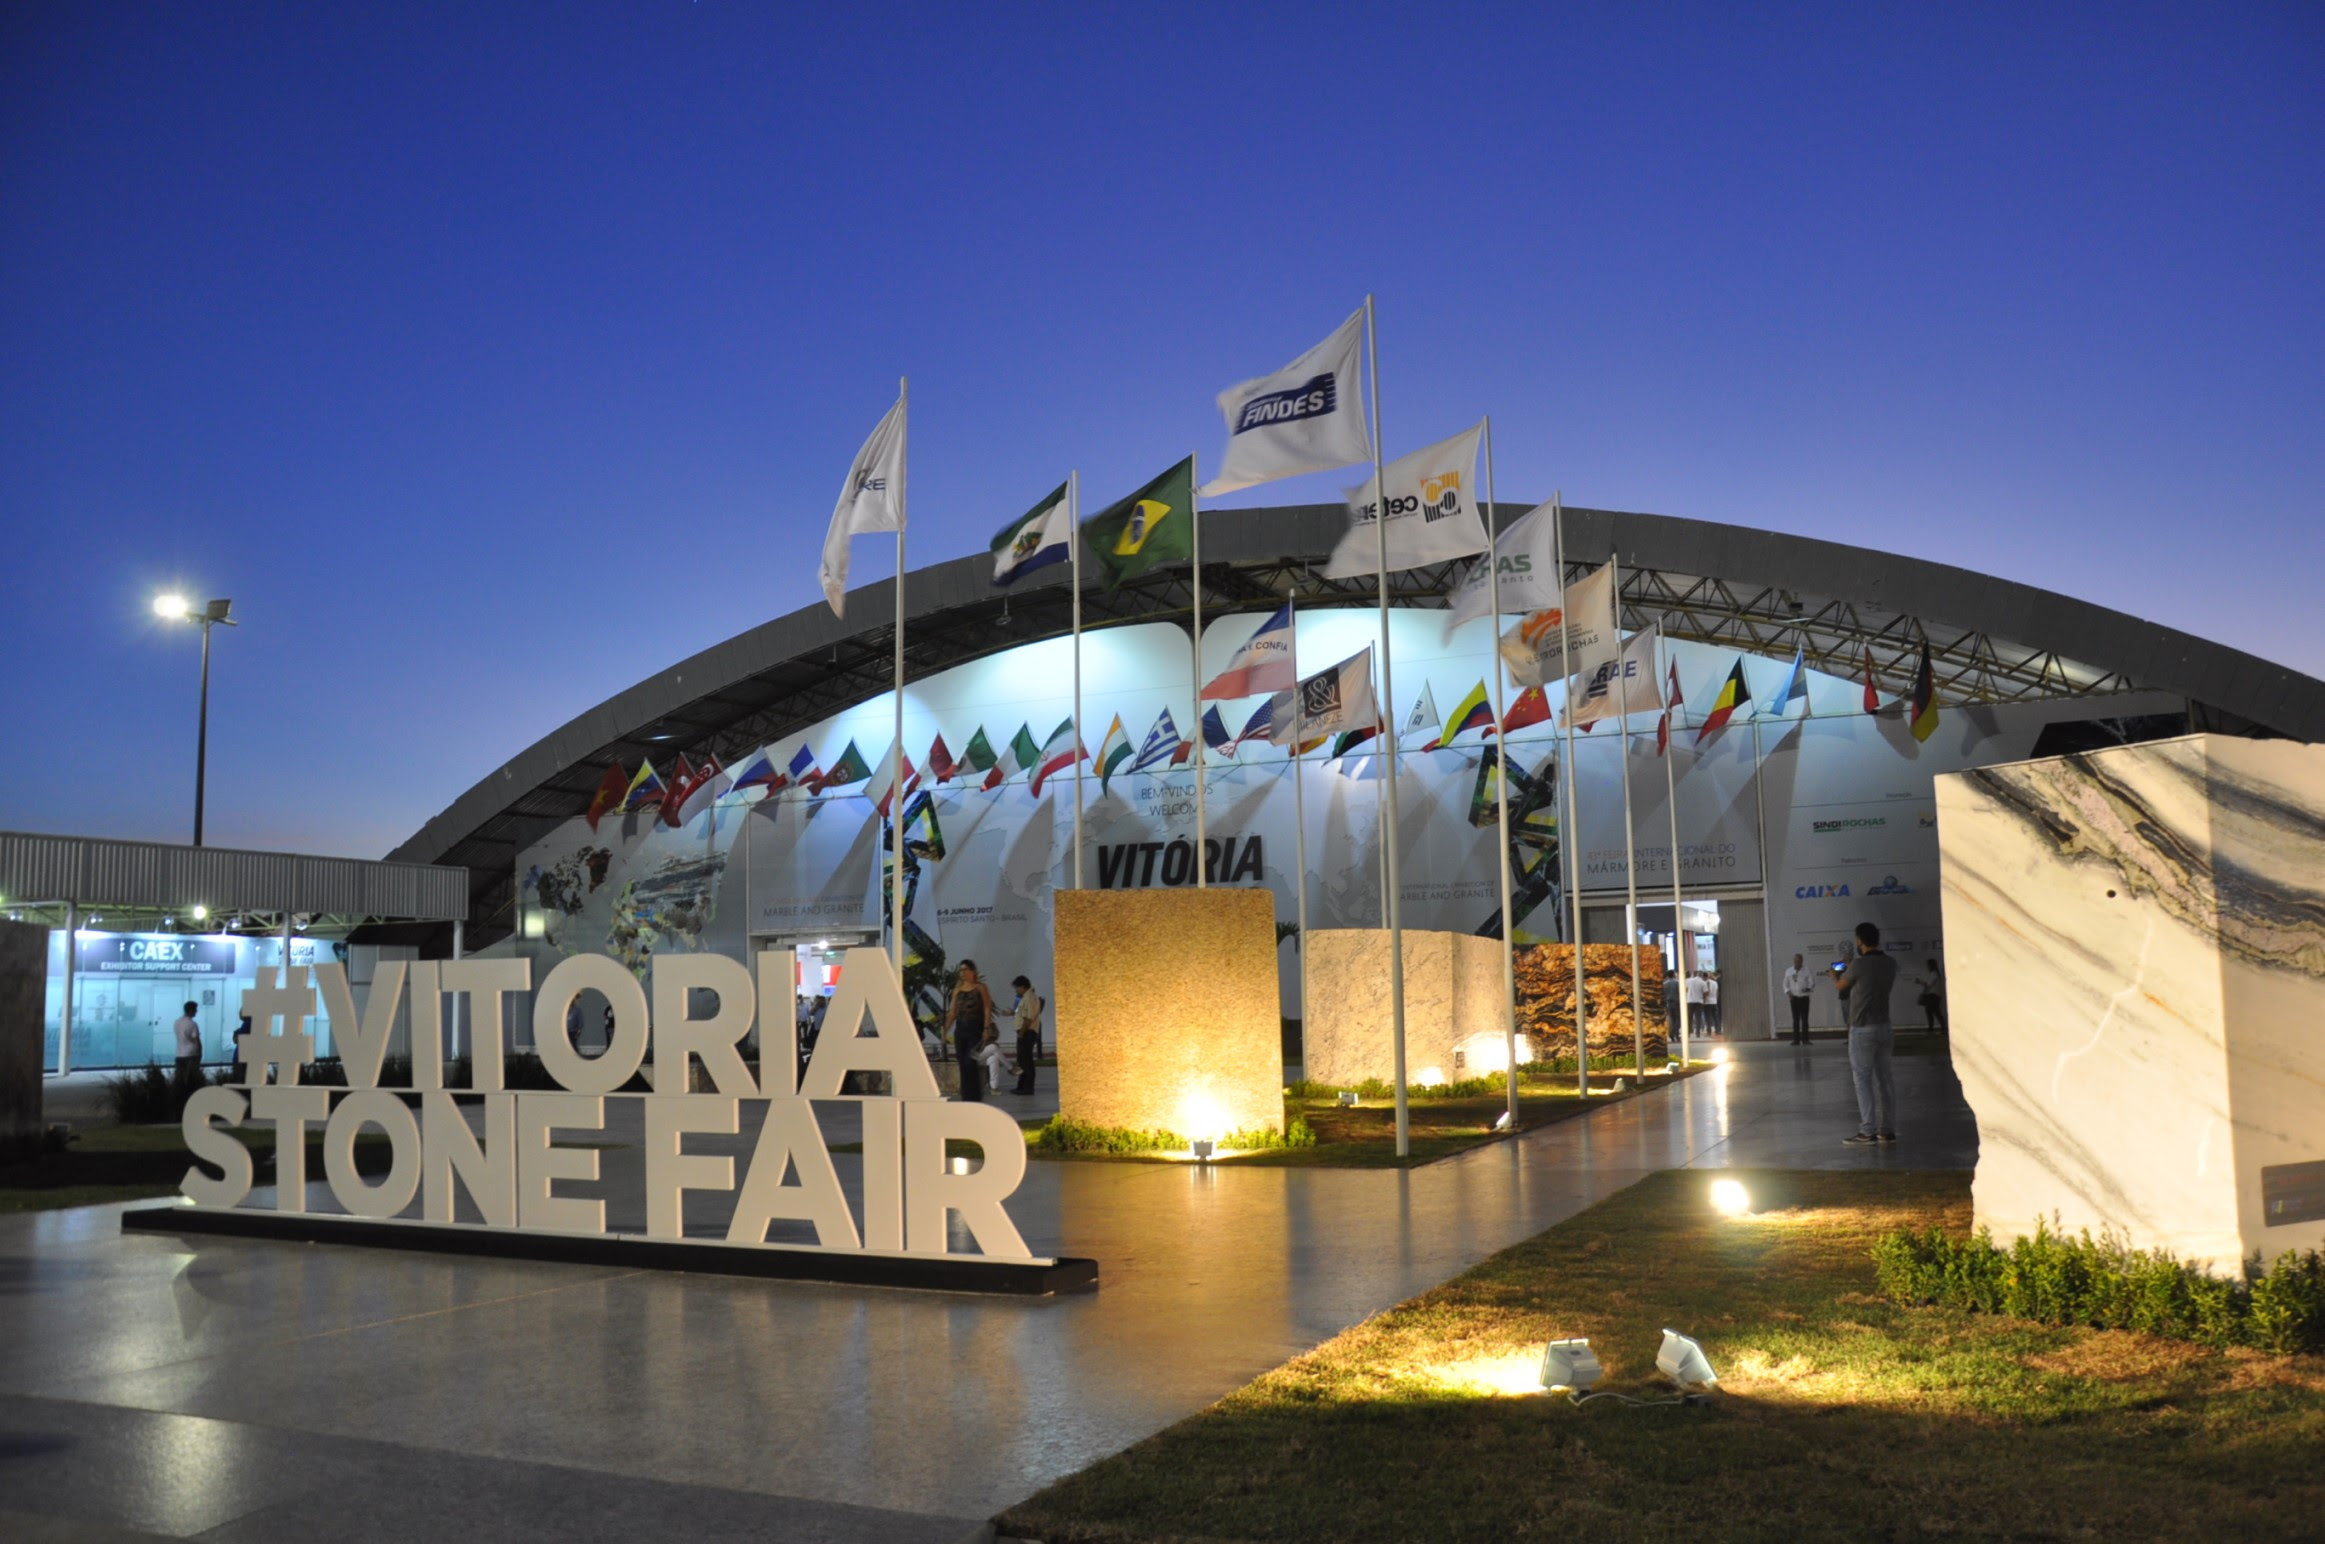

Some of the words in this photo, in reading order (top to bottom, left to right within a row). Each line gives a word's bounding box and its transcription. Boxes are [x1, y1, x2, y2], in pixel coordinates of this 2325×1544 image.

[1243, 390, 1325, 427] FINDES
[1256, 641, 1289, 653] CONFIA
[1719, 843, 1736, 854] DO
[1098, 834, 1264, 889] VITÓRIA
[1661, 860, 1668, 870] E
[1400, 892, 1426, 902] ARBLE
[1430, 891, 1451, 901] AND
[1453, 888, 1496, 899] GRANITE
[1795, 884, 1851, 899] CAIXA
[763, 906, 798, 917] MARBLE
[801, 904, 821, 915] AND
[823, 903, 865, 914] GRANITE
[950, 907, 975, 915] JUNHO
[976, 906, 994, 914] 2017
[130, 941, 184, 961] CAEX
[101, 961, 143, 970] EXHIBITOR
[145, 962, 180, 971] SUPPORT
[182, 963, 212, 971] CENTER
[238, 947, 943, 1099] #VITORIA
[179, 1085, 606, 1235] STONE
[645, 1097, 1034, 1259] FAIR
